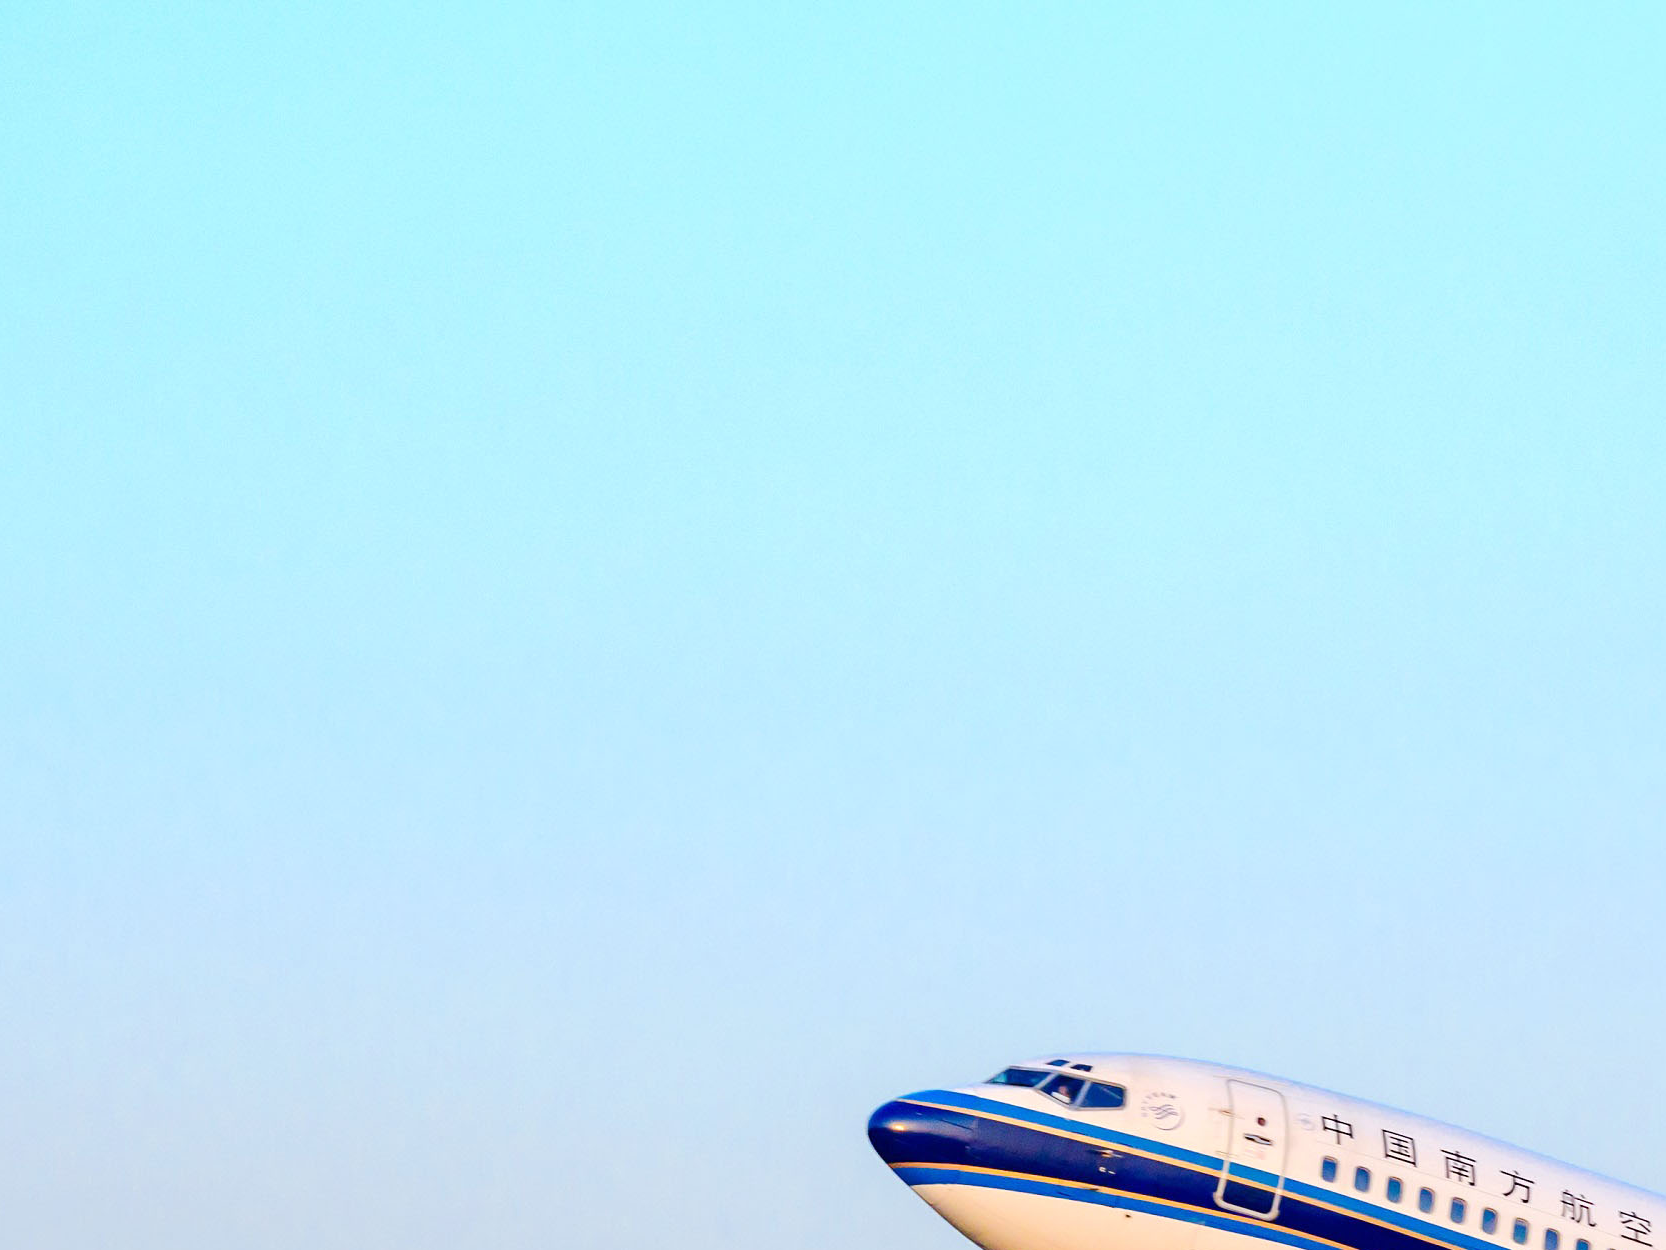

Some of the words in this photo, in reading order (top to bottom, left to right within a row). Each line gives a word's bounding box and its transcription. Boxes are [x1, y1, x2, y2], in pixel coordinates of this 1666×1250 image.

[1321, 1114, 1654, 1248] 中国南方航空
